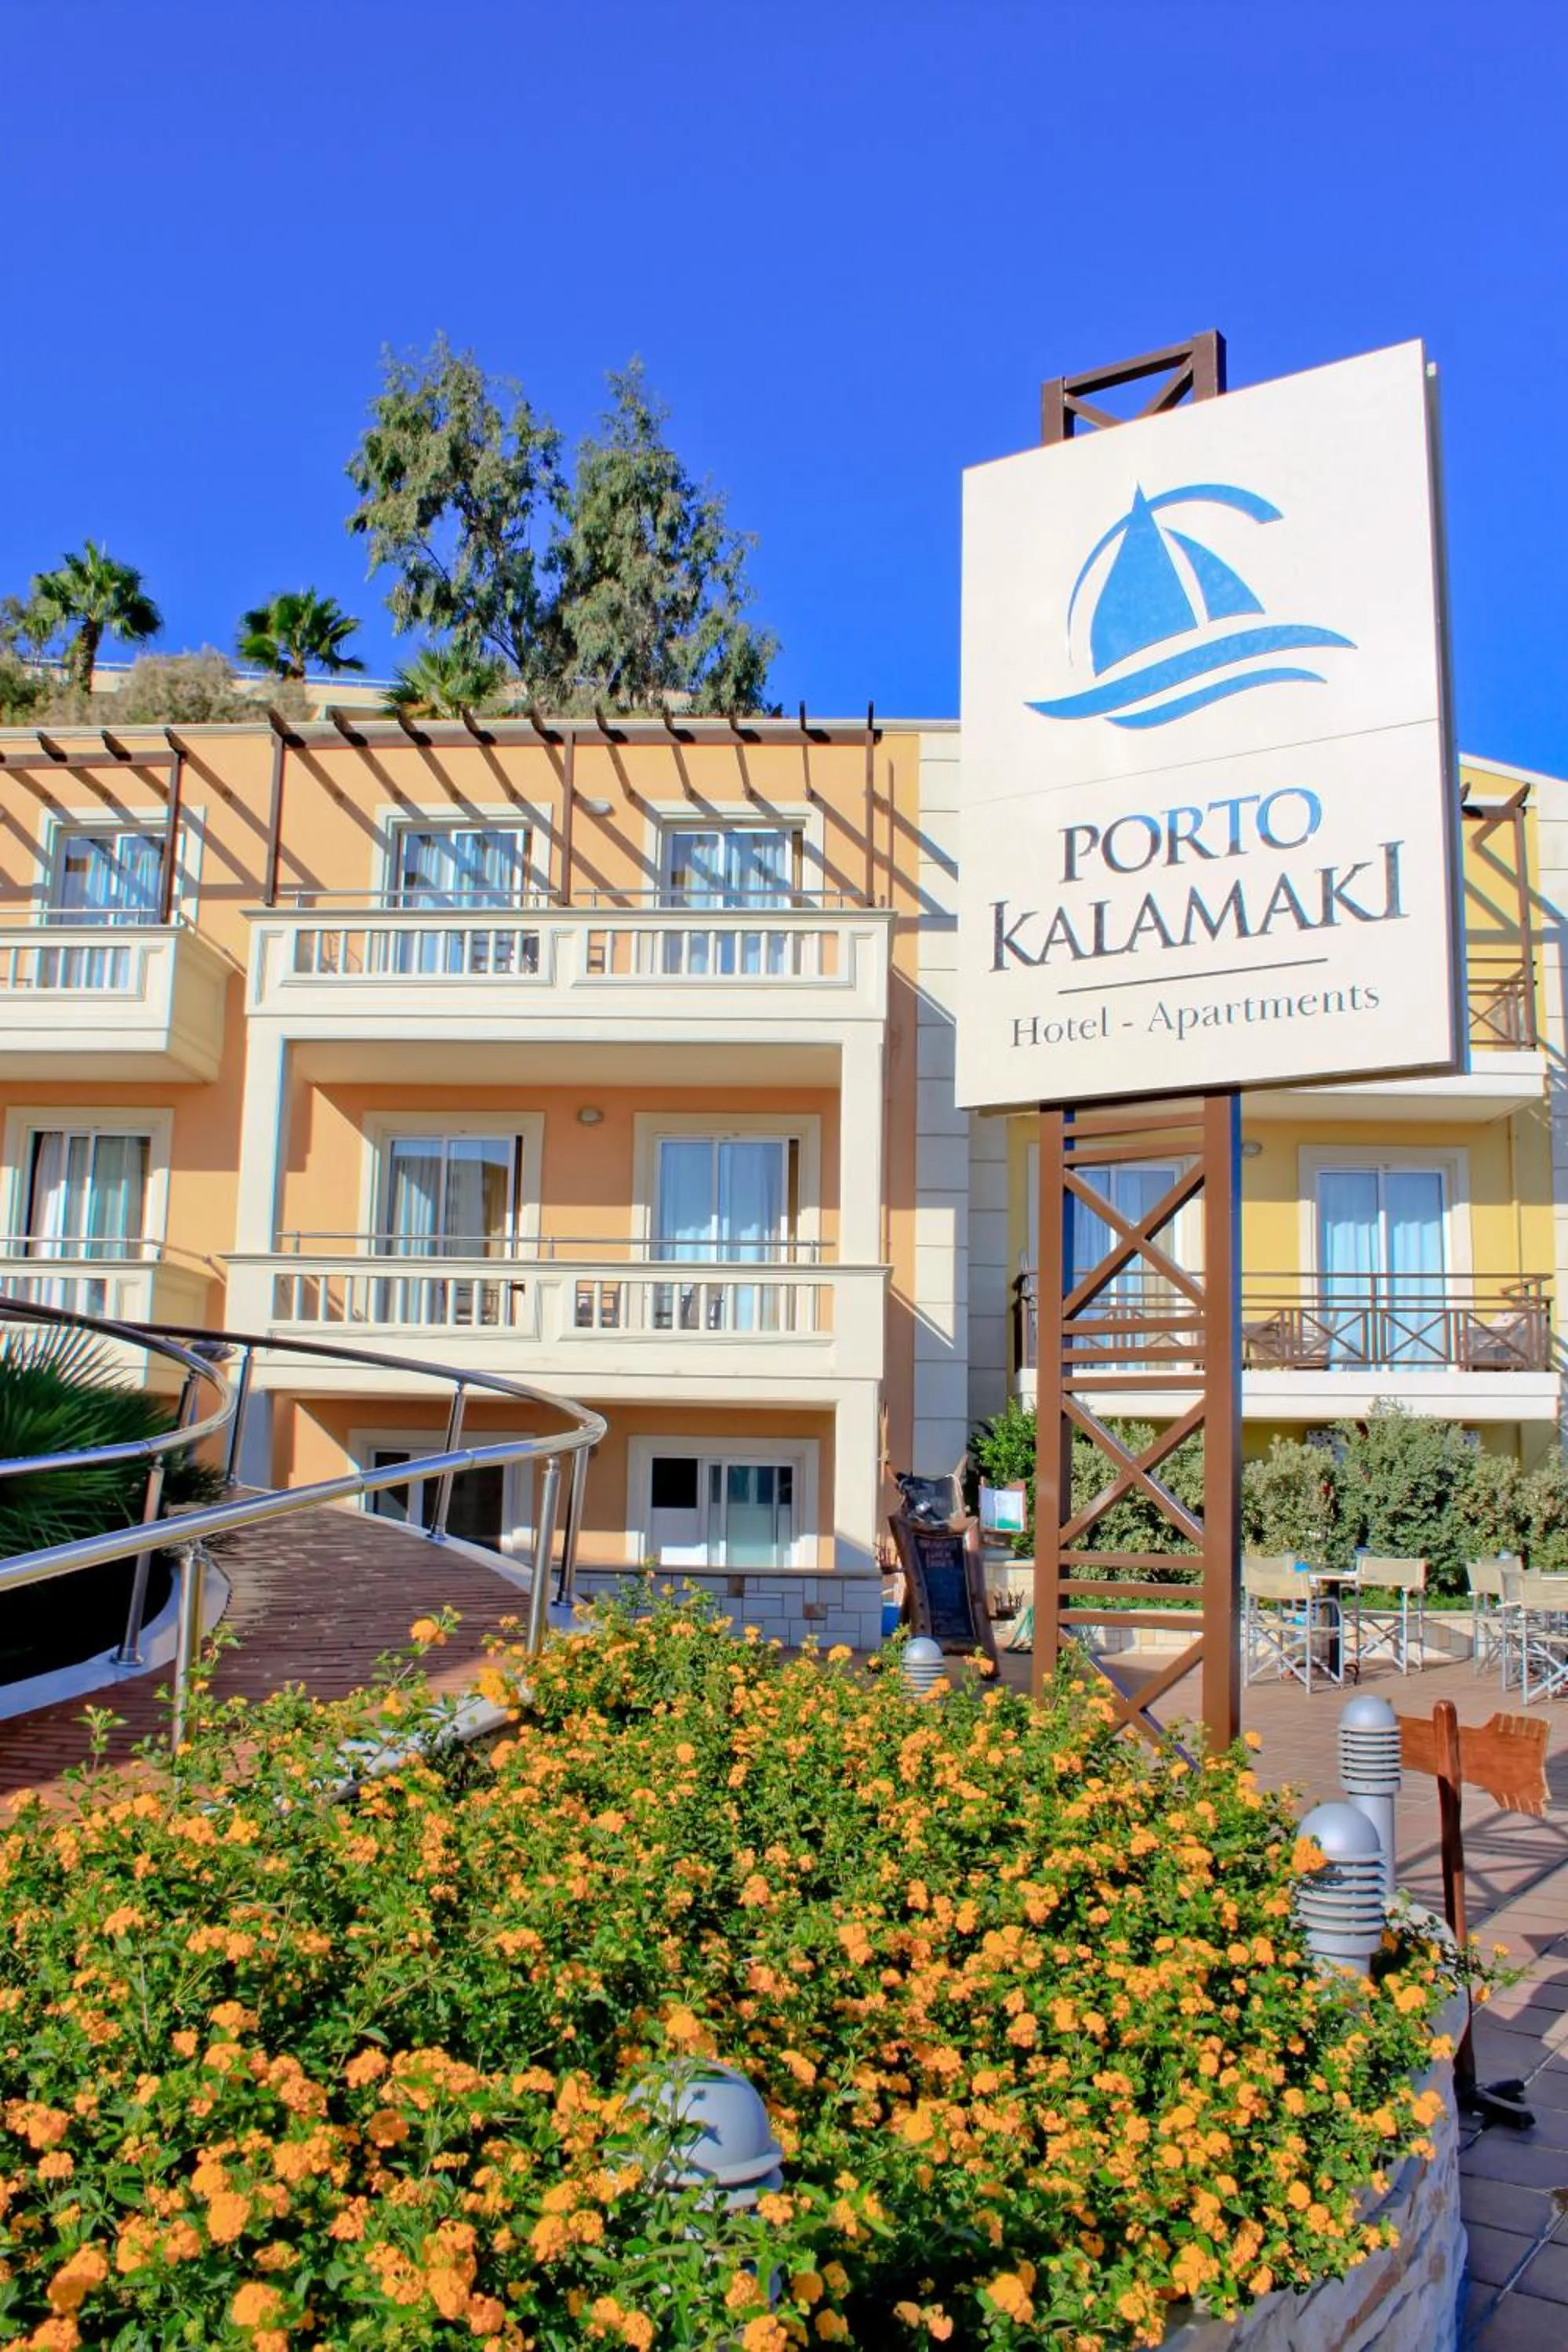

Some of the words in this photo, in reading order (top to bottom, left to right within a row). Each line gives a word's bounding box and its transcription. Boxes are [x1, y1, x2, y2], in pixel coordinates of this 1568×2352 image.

[1058, 787, 1323, 883] PORTO
[989, 840, 1410, 973] KALAMAKI
[1010, 1007, 1109, 1047] Hotel
[1147, 983, 1380, 1040] Apartments
